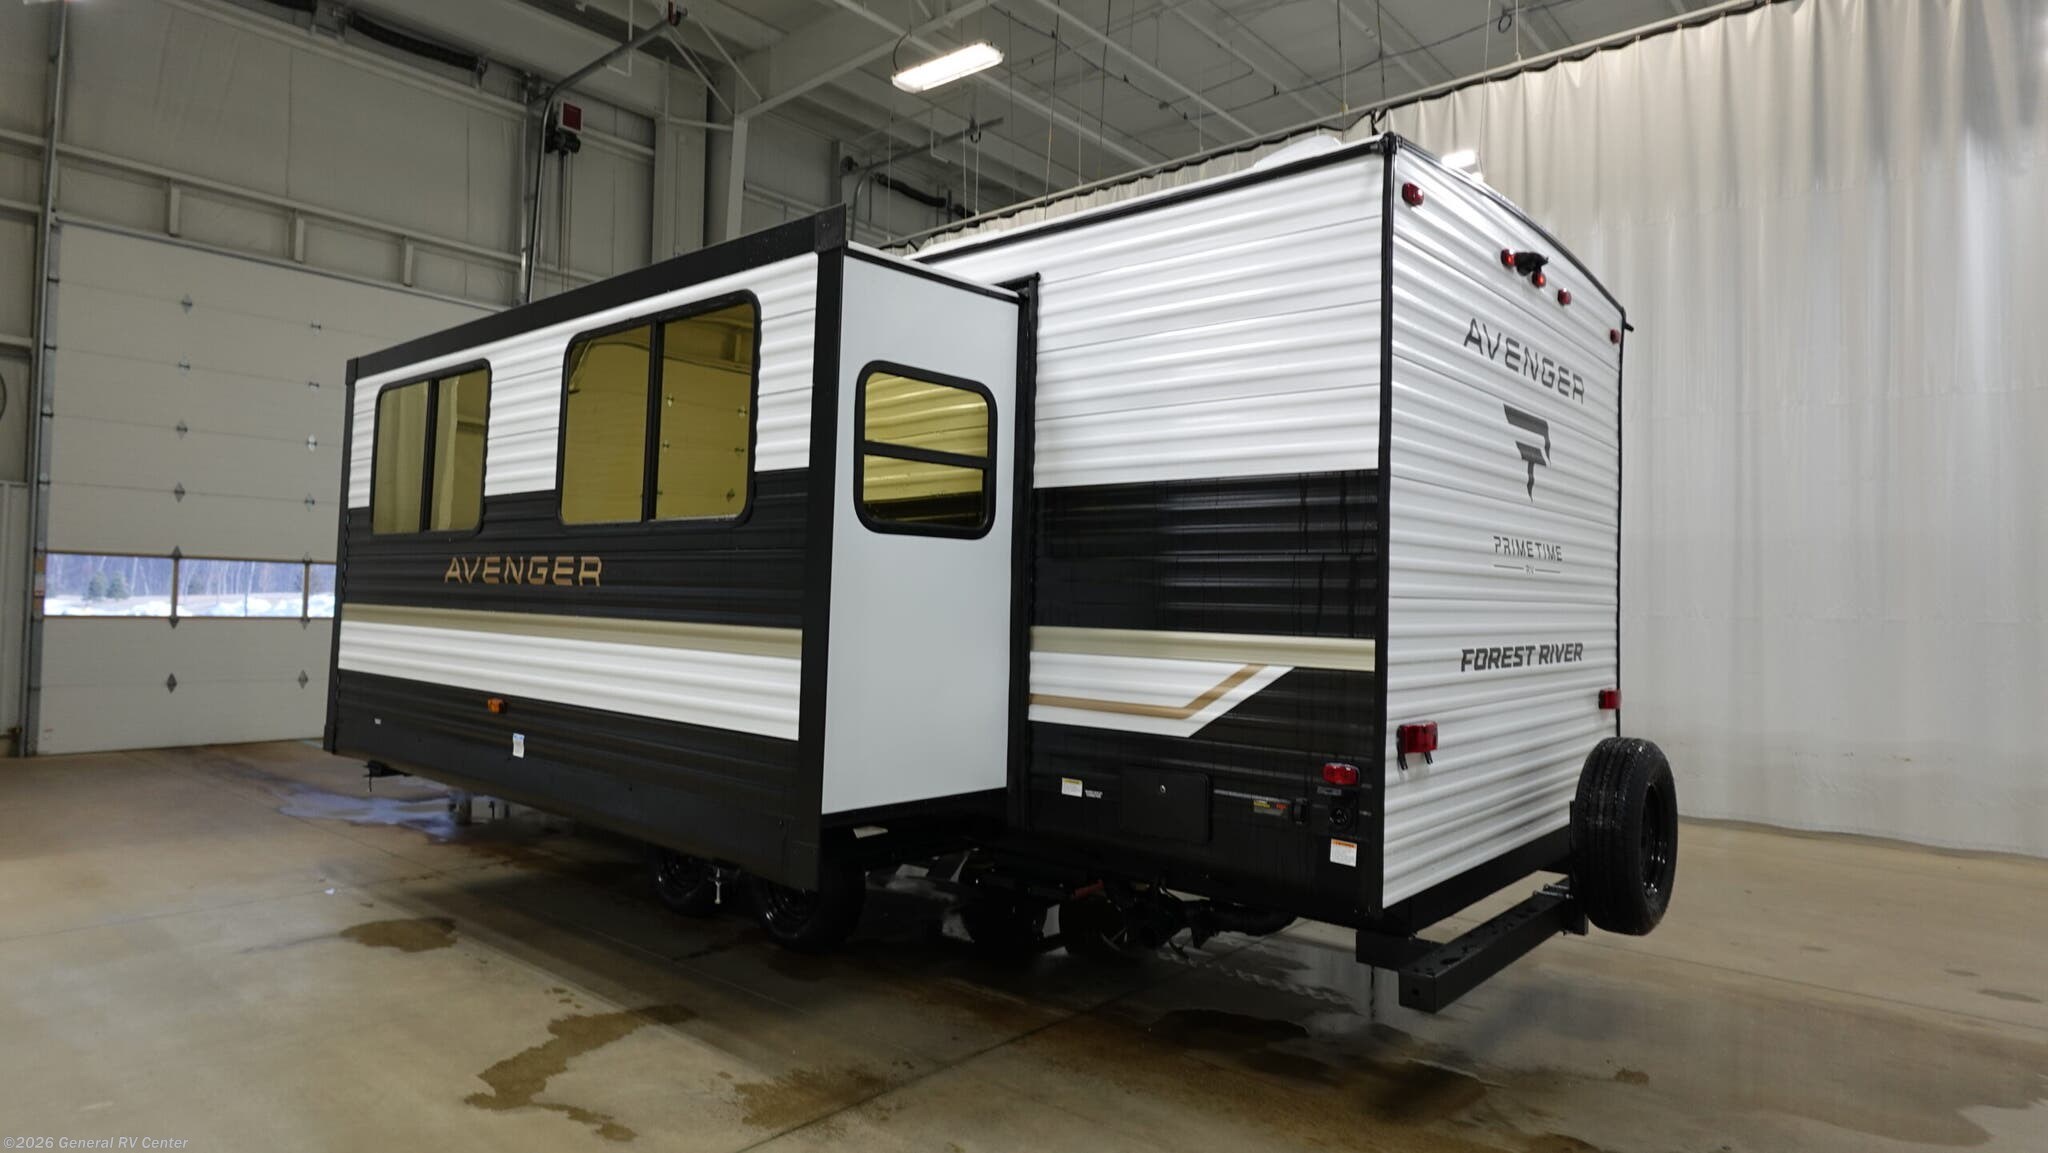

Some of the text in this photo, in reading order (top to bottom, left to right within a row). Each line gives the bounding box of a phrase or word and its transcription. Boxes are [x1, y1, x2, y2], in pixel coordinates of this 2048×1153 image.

[1463, 318, 1585, 405] AVENGER
[444, 556, 602, 587] AVENGER
[1461, 642, 1584, 672] FOREST RIVER
